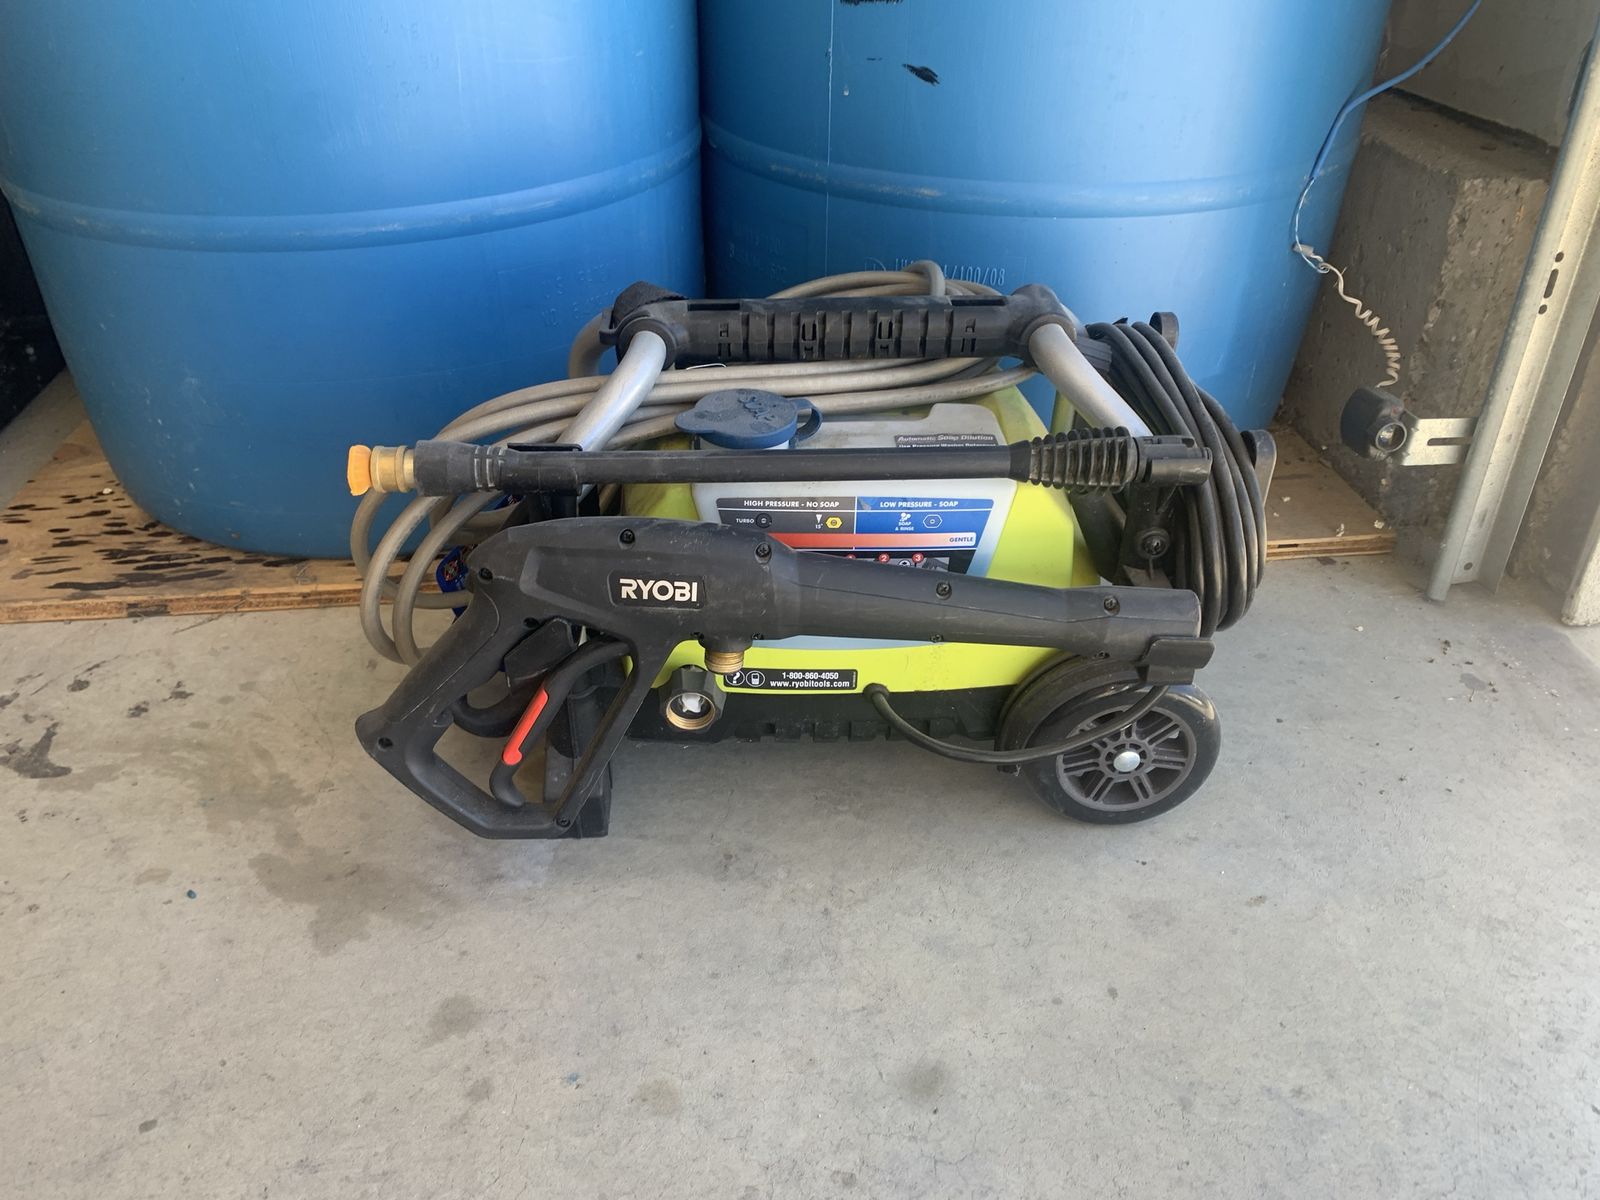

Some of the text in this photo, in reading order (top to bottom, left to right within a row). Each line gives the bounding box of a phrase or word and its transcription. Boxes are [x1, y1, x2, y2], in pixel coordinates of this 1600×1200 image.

[765, 500, 800, 508] PRESSURE
[619, 578, 698, 602] RYOBI
[781, 671, 839, 680] 1-800-860-4050
[769, 680, 850, 688] www.ryobitools.com
